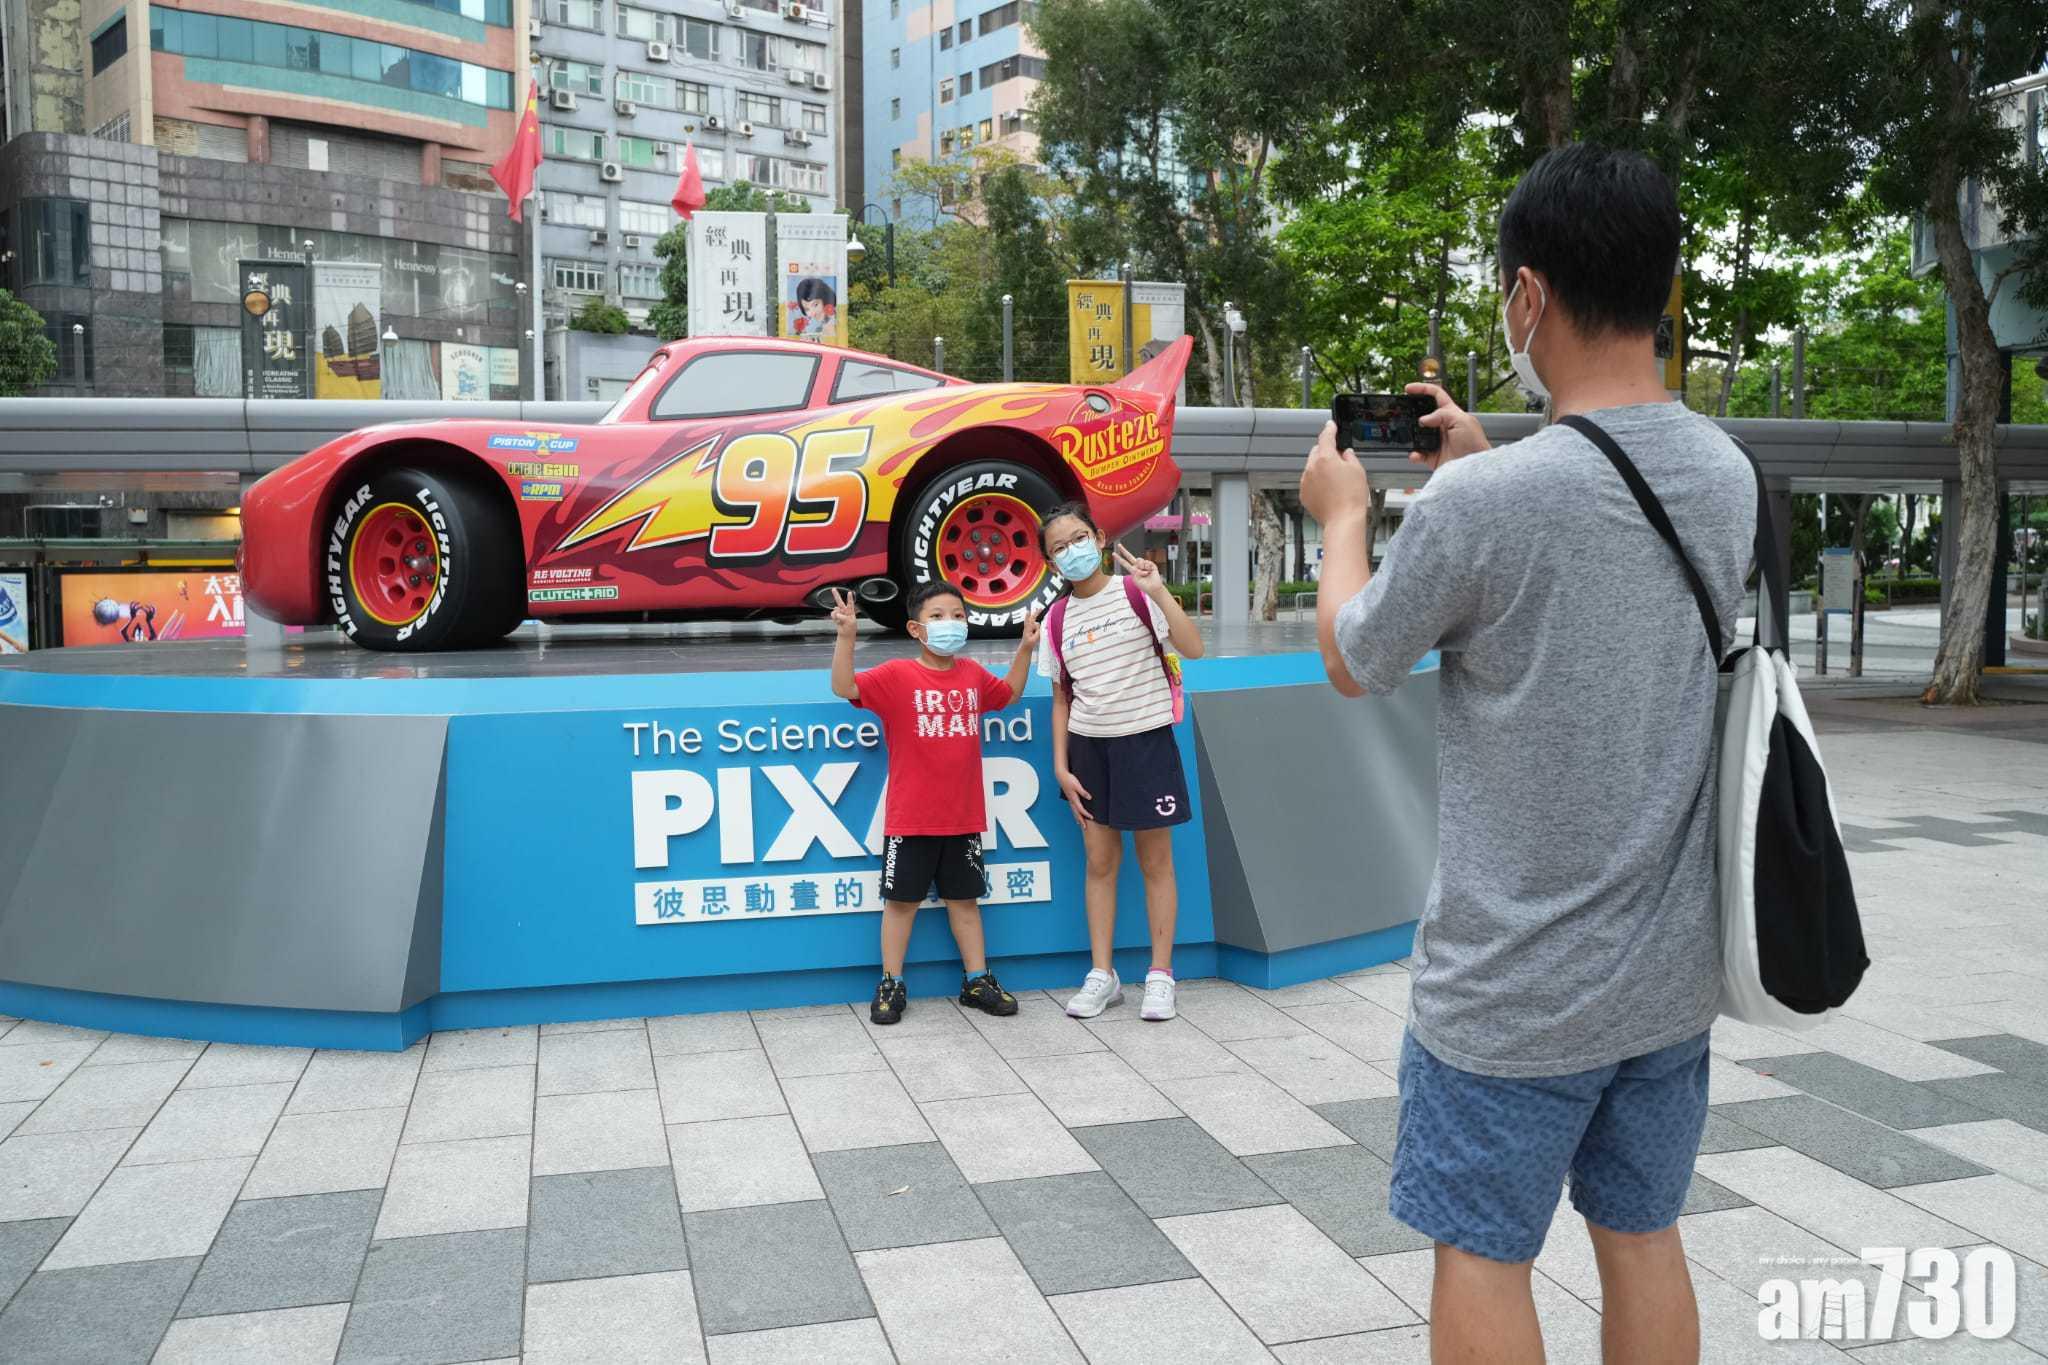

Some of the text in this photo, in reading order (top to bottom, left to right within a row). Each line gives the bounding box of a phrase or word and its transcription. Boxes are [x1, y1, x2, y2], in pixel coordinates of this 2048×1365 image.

[394, 258, 436, 276] Hennessy
[706, 225, 756, 322] 經典再現
[1077, 292, 1115, 370] 經典再現
[493, 437, 574, 449] PISTON CUP
[709, 428, 874, 559] 95
[914, 473, 1018, 584] LIGHTYEAR
[328, 484, 374, 636] LIGHTYEAR
[397, 488, 450, 641] LIGHTYEAR
[623, 717, 879, 756] The Science
[914, 688, 978, 712] IRON
[916, 713, 979, 737] MAN
[631, 757, 1049, 868] PIXR
